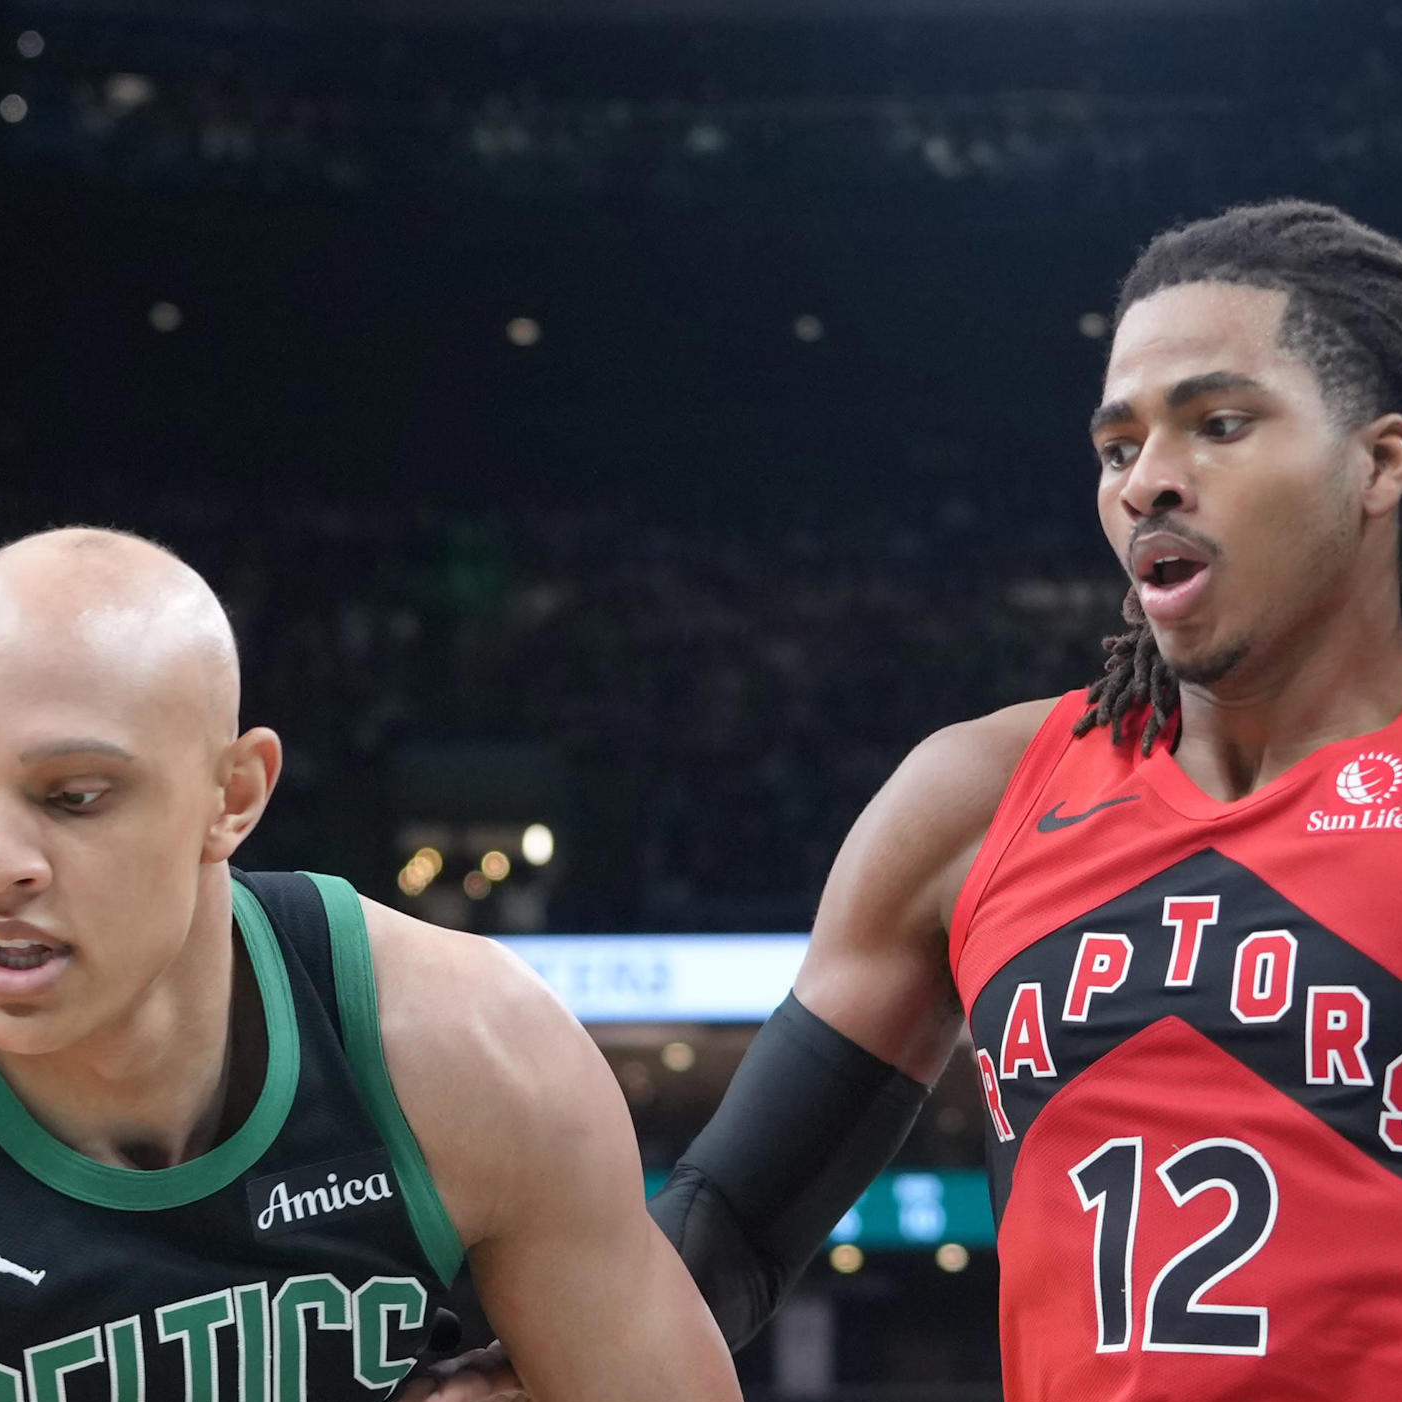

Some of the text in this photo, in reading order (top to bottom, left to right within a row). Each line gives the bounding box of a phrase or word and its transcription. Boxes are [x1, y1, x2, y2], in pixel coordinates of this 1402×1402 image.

[1306, 810, 1356, 832] Sun
[257, 1172, 394, 1231] Amica
[1068, 1136, 1279, 1357] 12
